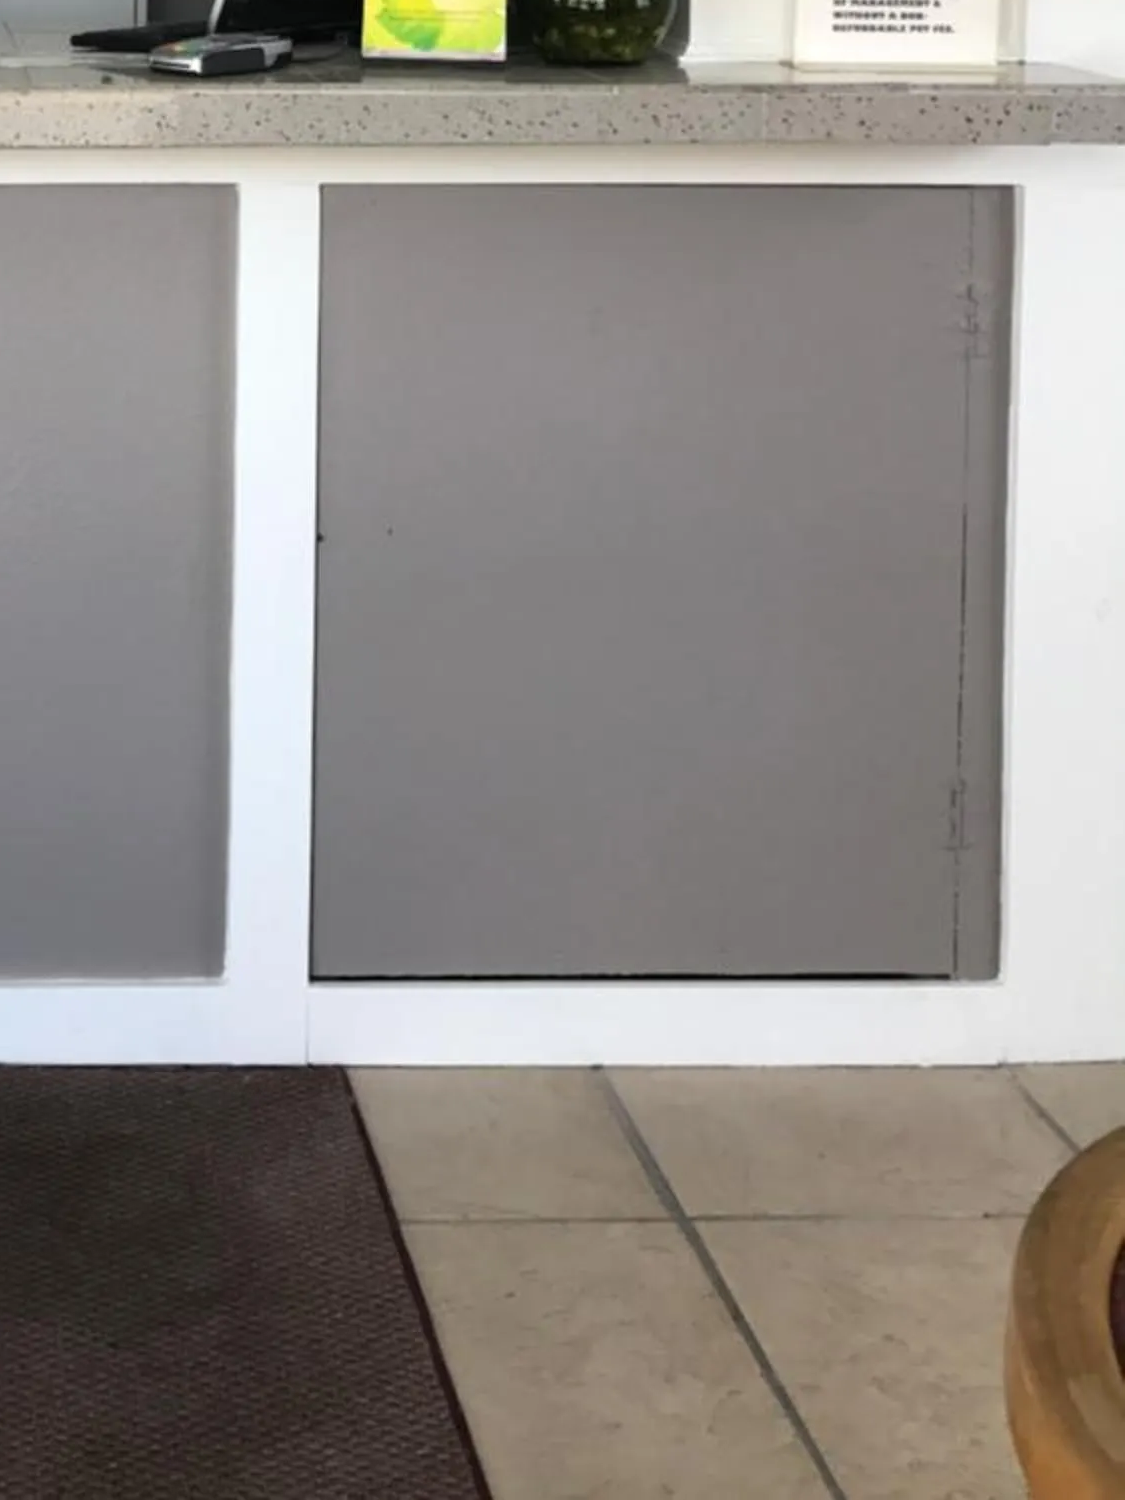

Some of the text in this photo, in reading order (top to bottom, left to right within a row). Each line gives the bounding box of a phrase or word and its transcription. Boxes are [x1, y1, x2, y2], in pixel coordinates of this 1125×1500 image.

[832, 11, 885, 21] WITHOUT
[888, 11, 897, 21] A
[831, 23, 906, 34] REFUNDABLE
[909, 23, 930, 34] PET
